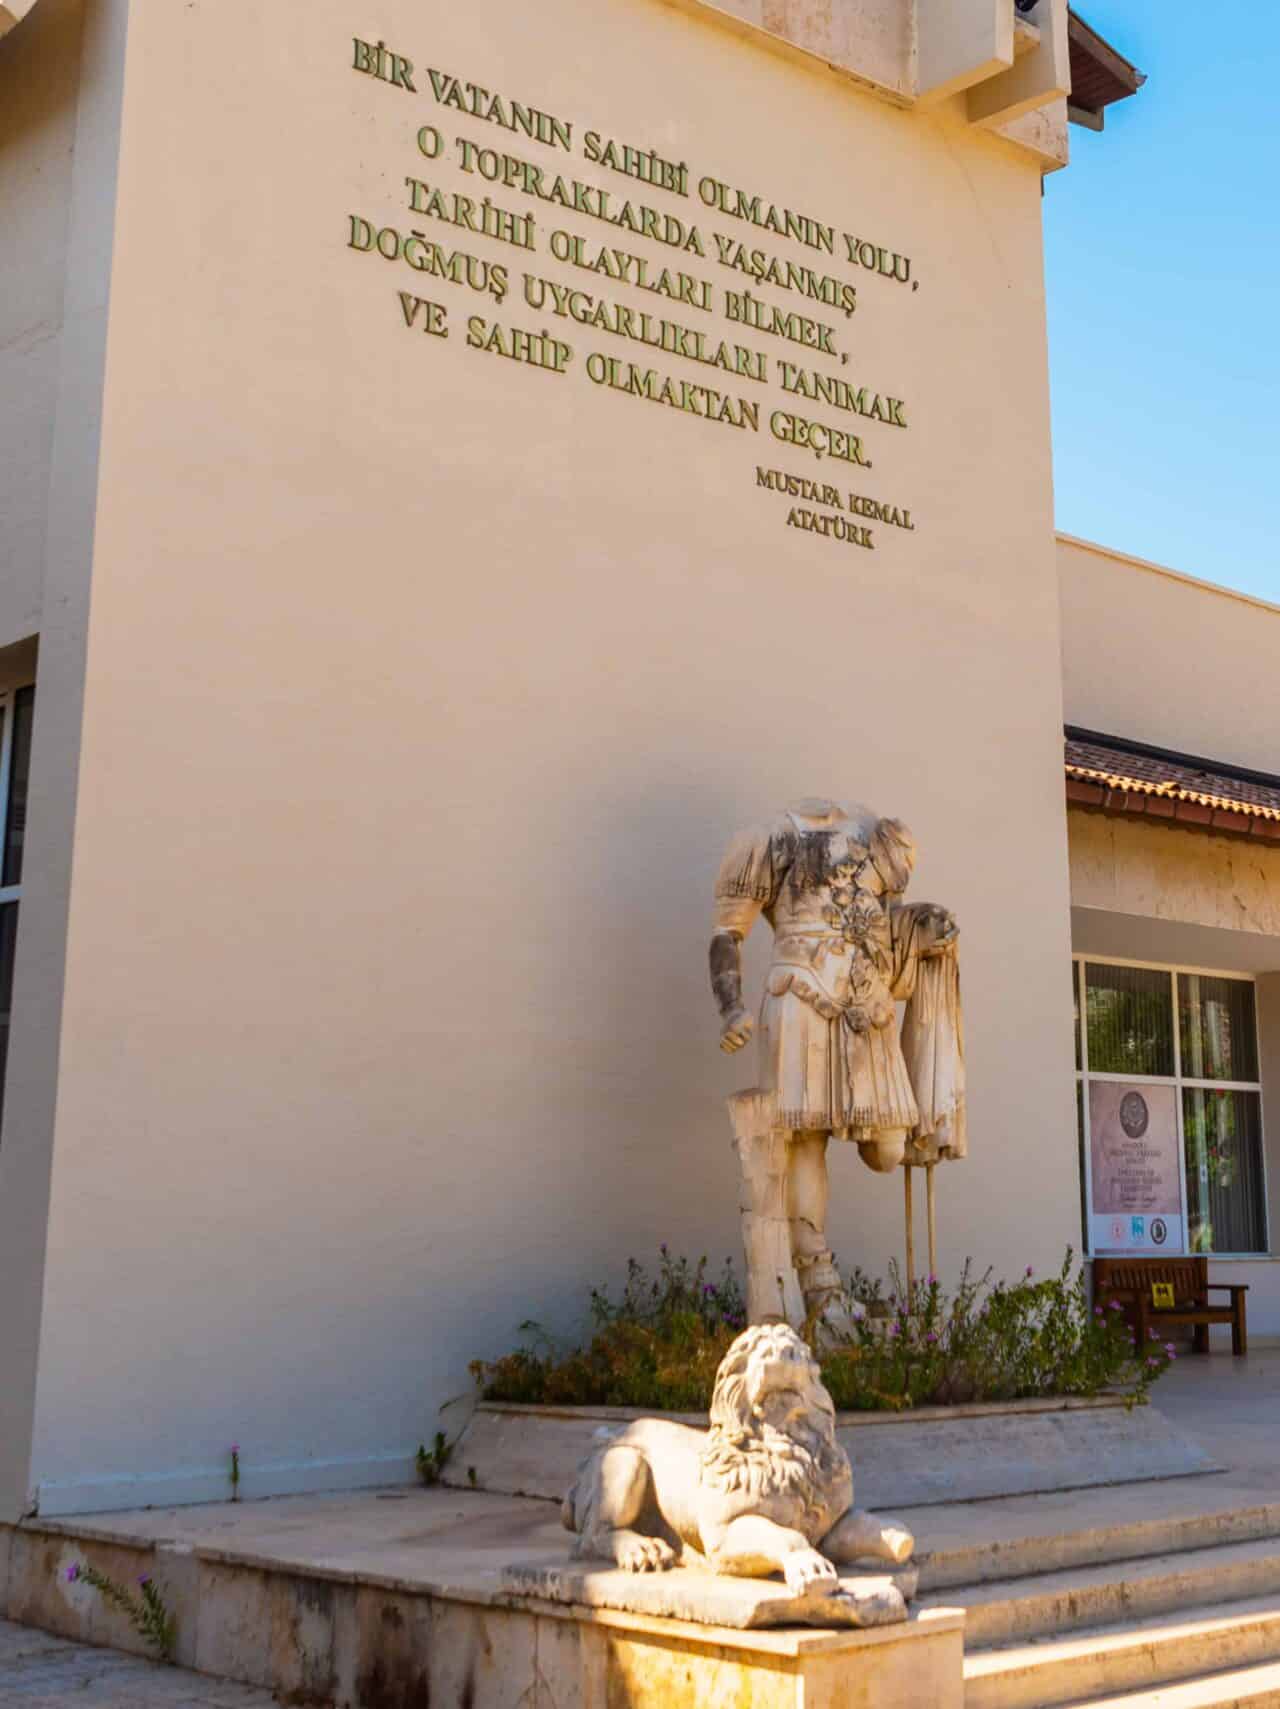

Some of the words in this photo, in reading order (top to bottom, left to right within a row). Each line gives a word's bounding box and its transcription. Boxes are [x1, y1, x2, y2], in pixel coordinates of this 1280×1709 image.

[352, 37, 417, 92] BİR
[427, 67, 573, 152] VATANIN
[583, 131, 690, 198] SAHİBİ
[698, 176, 836, 255] OLMANIN
[842, 232, 920, 292] YOLU,
[405, 177, 537, 251] TARİHİ
[549, 230, 713, 312] OLAYLARI
[416, 125, 444, 159] O
[455, 137, 706, 257] TOPRAKLARDA
[712, 233, 858, 318] YAŞANMIŞ
[347, 214, 509, 302] DOĞMUŞ
[521, 273, 769, 384] UYGARLIKLARI
[776, 360, 908, 427] TANIMAK
[398, 291, 448, 338] VE
[466, 315, 574, 373] SAHİP
[585, 352, 760, 432] OLMAKTAN
[769, 410, 873, 468] GEÇER.
[756, 466, 844, 510] MUSTAFA
[848, 493, 915, 531] KEMAL
[786, 507, 875, 550] ATATÜRK
